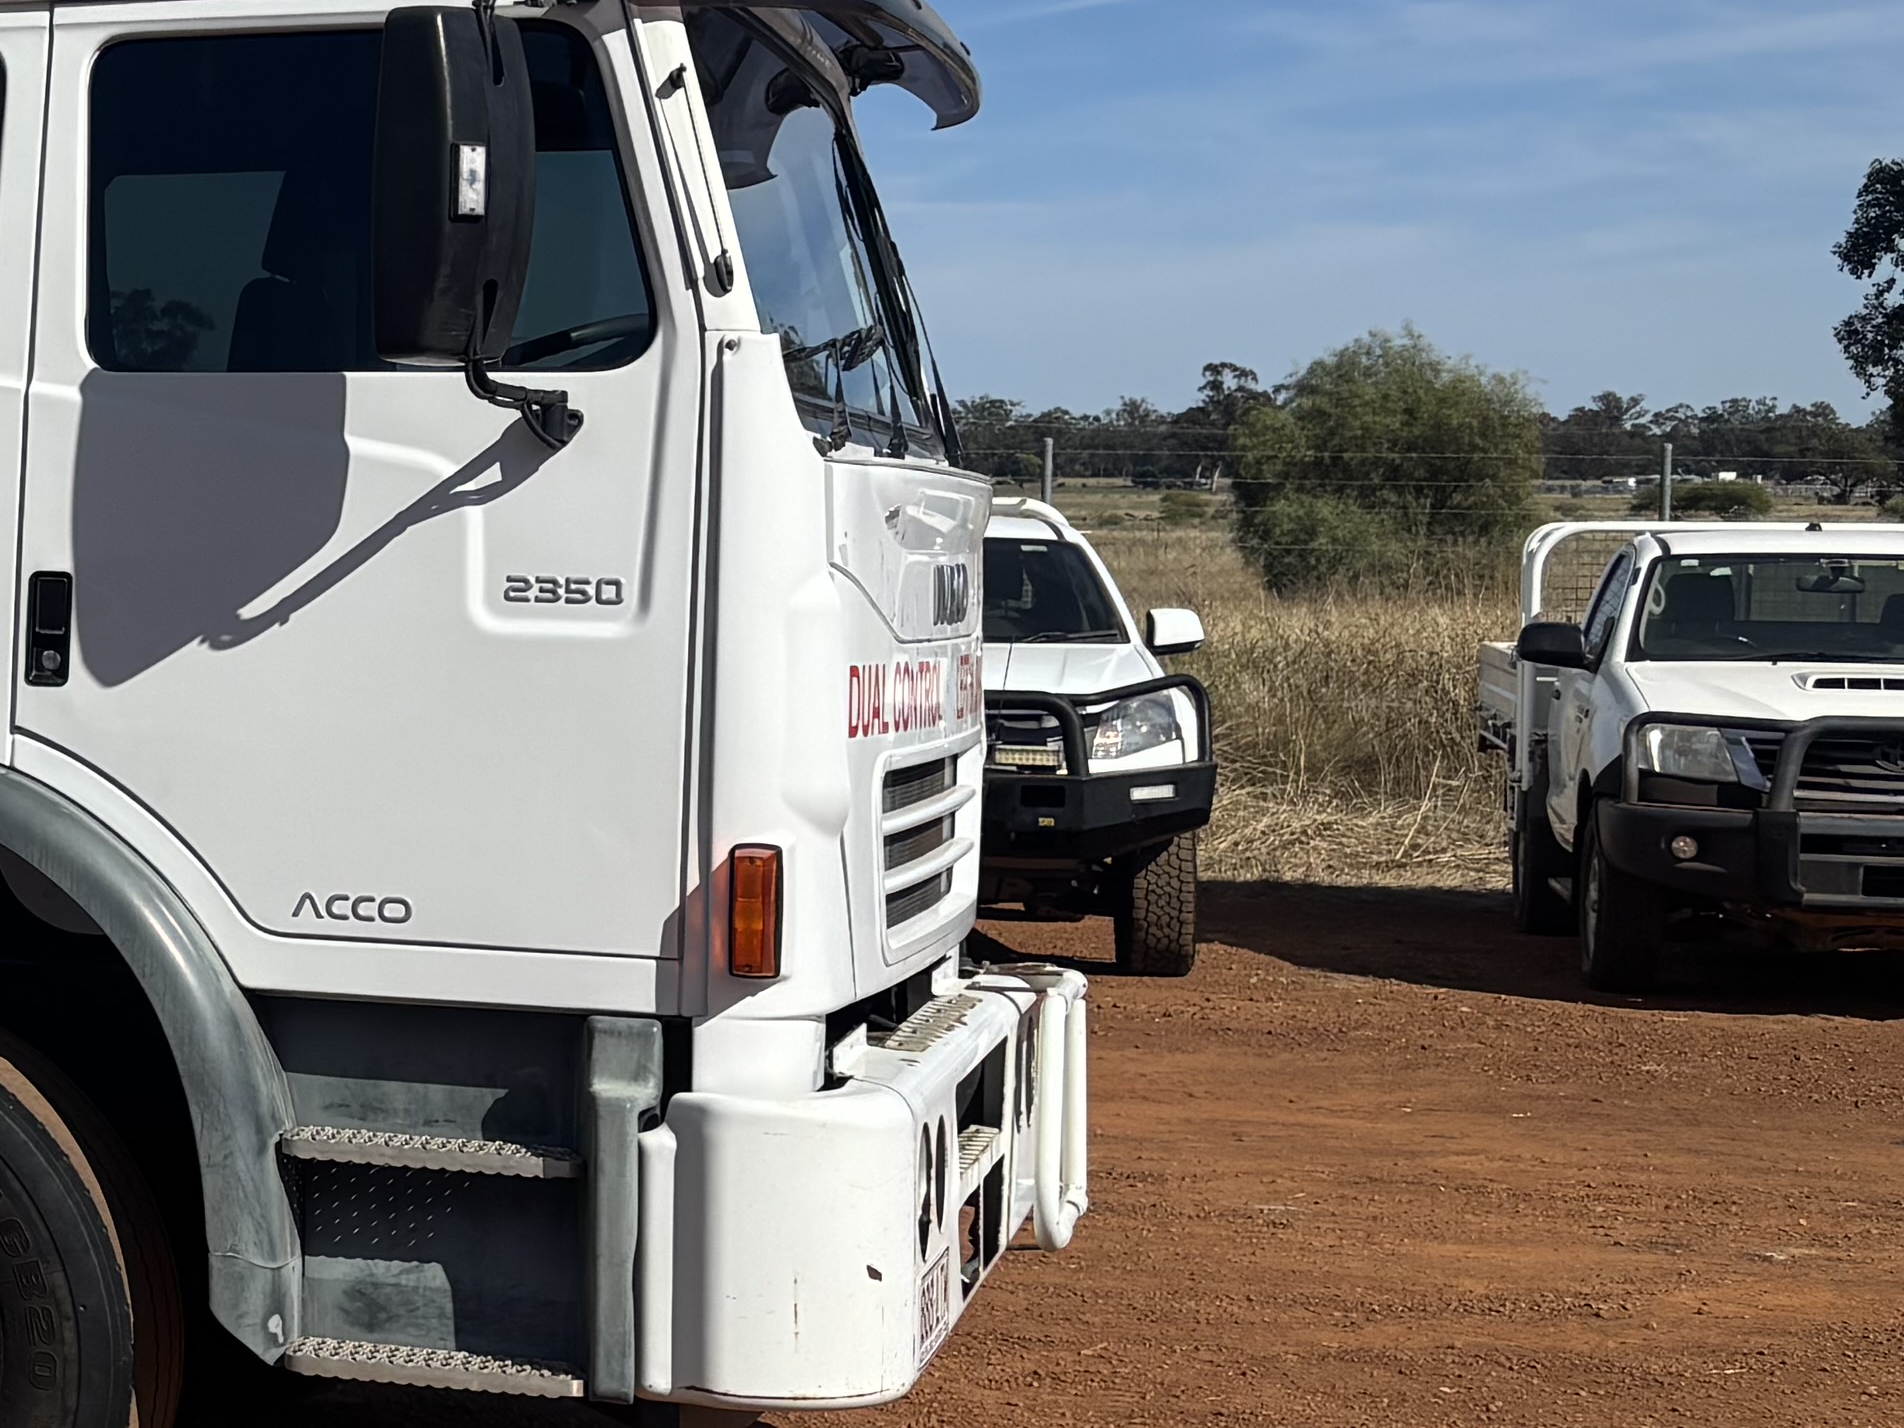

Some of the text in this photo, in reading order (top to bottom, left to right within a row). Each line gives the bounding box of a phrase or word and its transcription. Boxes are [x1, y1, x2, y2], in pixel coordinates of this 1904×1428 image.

[503, 574, 624, 606] 2350
[848, 663, 890, 739] DUAL
[893, 661, 943, 733] CONTROL
[291, 891, 412, 924] ACCO
